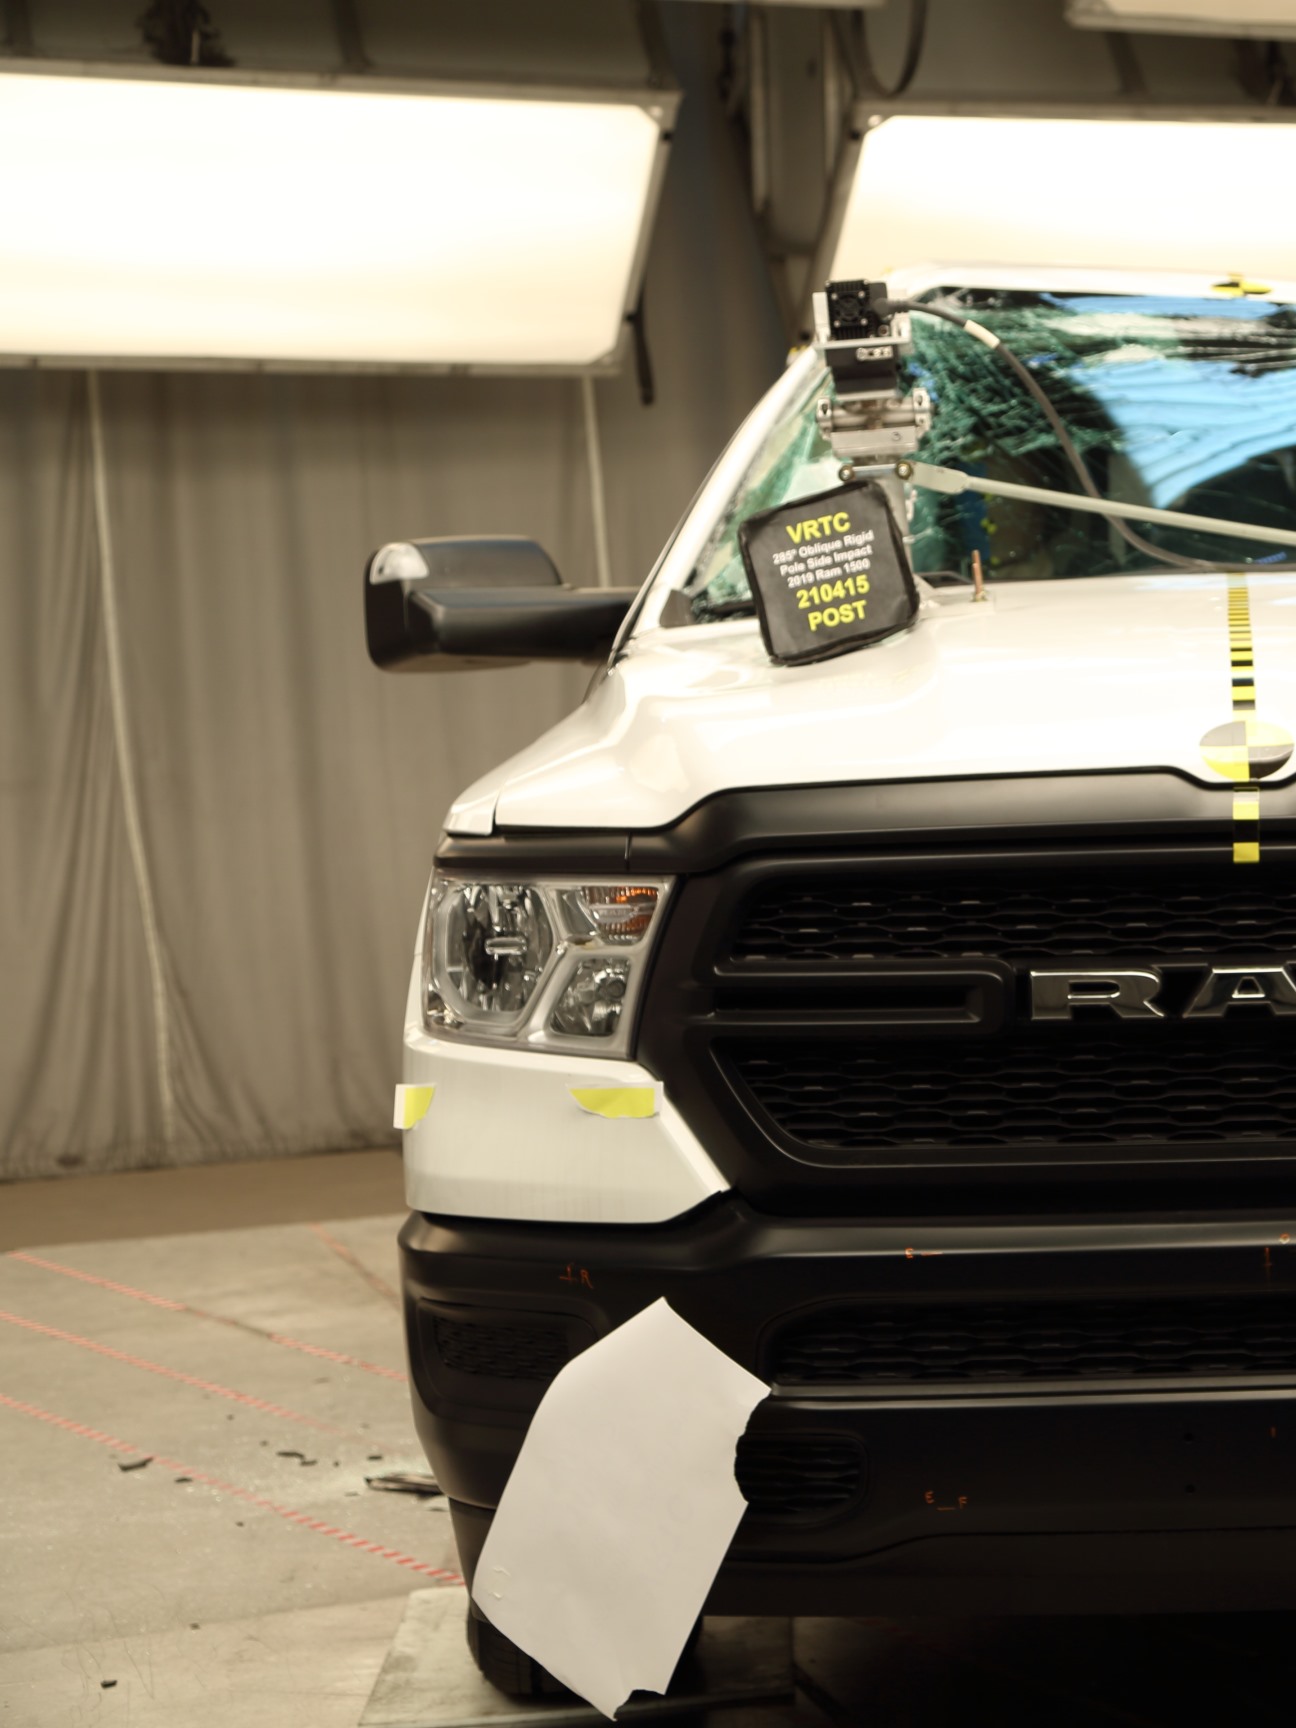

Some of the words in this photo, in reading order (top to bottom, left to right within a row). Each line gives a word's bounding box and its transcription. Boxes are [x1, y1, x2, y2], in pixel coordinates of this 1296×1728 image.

[785, 512, 851, 544] VRTC
[798, 540, 843, 557] Oblique
[843, 530, 874, 546] Rigid
[780, 562, 806, 576] Pole
[806, 555, 833, 570] Side
[833, 544, 873, 562] Impact
[787, 572, 815, 588] 2019
[815, 567, 842, 580] Ram
[843, 557, 871, 573] 1500
[796, 574, 870, 609] 210415
[807, 600, 867, 631] POST
